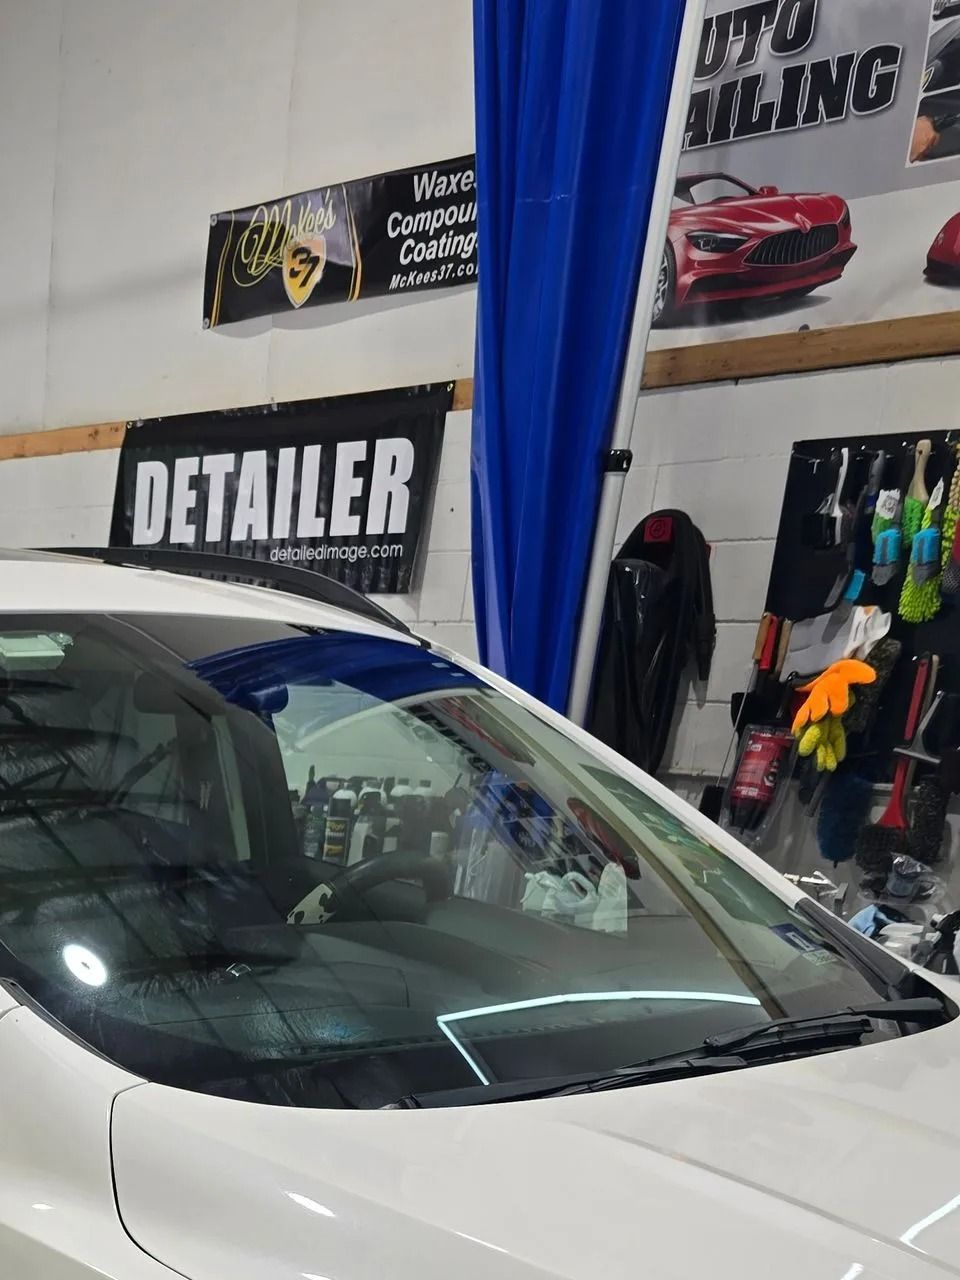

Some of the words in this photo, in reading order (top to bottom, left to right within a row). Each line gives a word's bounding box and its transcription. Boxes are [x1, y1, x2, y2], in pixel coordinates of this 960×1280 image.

[413, 169, 477, 202] Waxe
[232, 188, 337, 287] McKee's
[399, 229, 478, 266] Coating
[289, 252, 320, 288] 37
[131, 437, 416, 547] DETAILER
[269, 543, 404, 563] detailedimage.com
